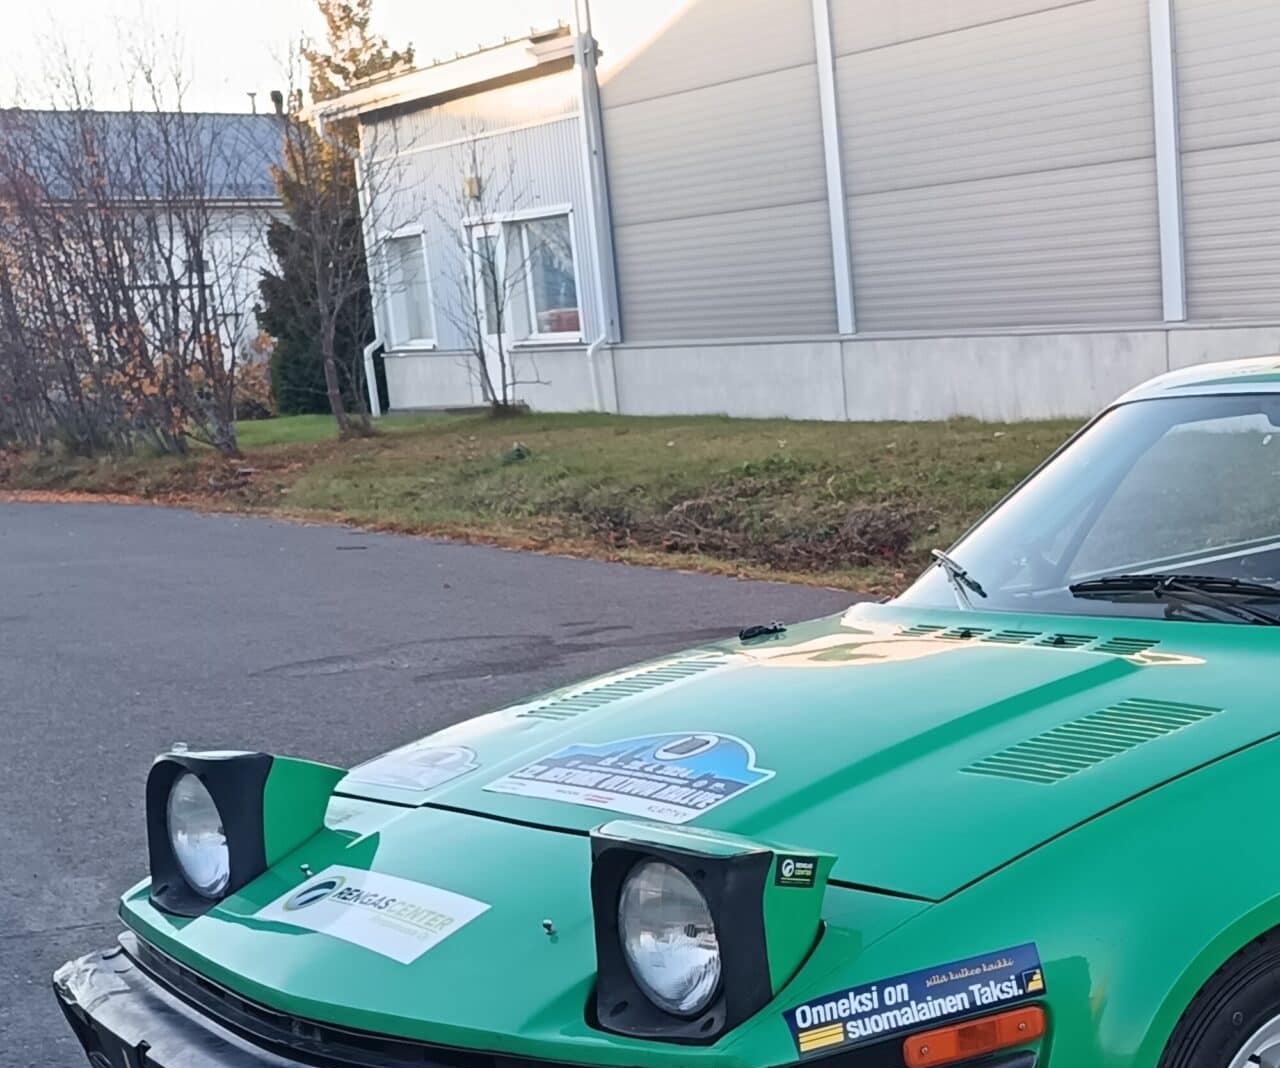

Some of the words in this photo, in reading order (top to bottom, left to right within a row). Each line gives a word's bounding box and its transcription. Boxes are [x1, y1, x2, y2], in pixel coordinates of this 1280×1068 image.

[795, 985, 879, 1028] Onneksi
[883, 983, 909, 1006] on
[846, 992, 970, 1039] suomalainen
[968, 975, 1024, 1006] Taksi.
